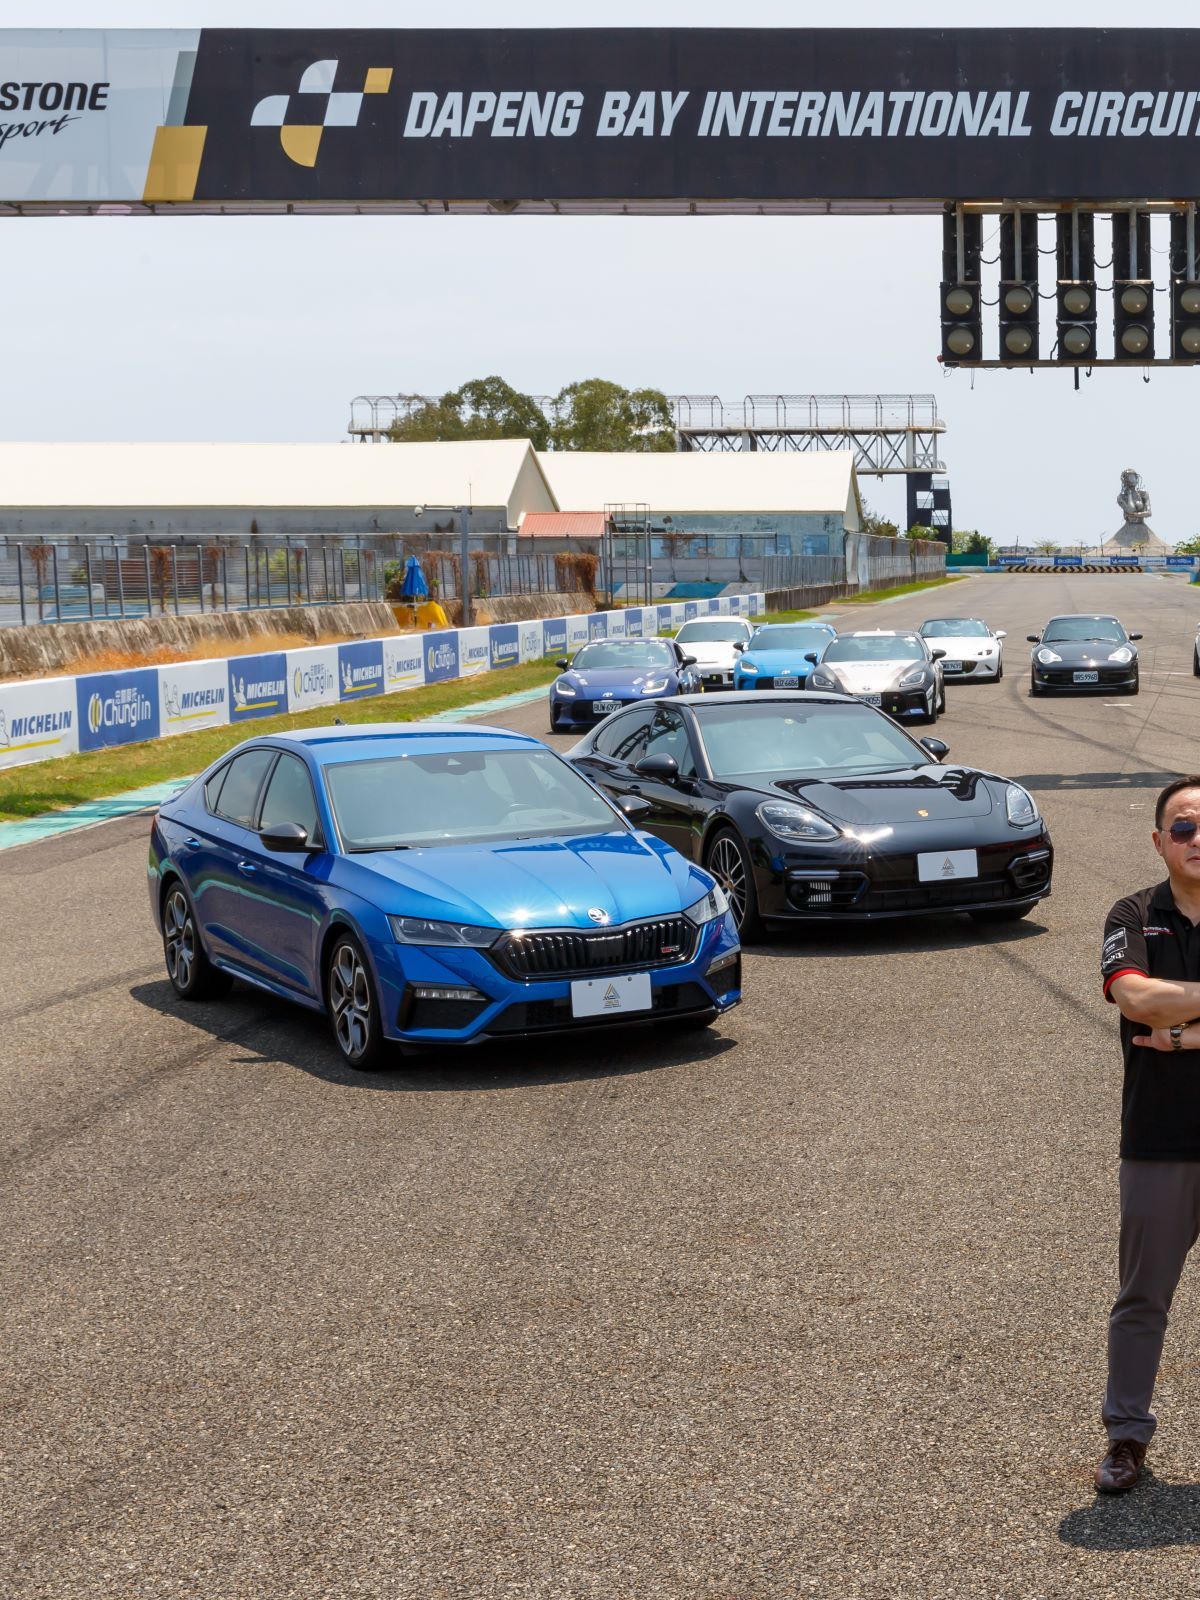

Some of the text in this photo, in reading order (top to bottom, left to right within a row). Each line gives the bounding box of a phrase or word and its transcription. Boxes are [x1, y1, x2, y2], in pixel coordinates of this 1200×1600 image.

[403, 91, 584, 138] DAPENG
[596, 91, 690, 137] BAY
[698, 91, 1032, 137] INTERNATIONAL
[353, 664, 383, 682] MICHELIN
[396, 657, 422, 673] MICHELIN
[181, 687, 226, 710] MICHELIN
[246, 679, 286, 700] MICHELIN
[104, 693, 152, 728] Chunglin
[11, 710, 72, 738] MICHELIN
